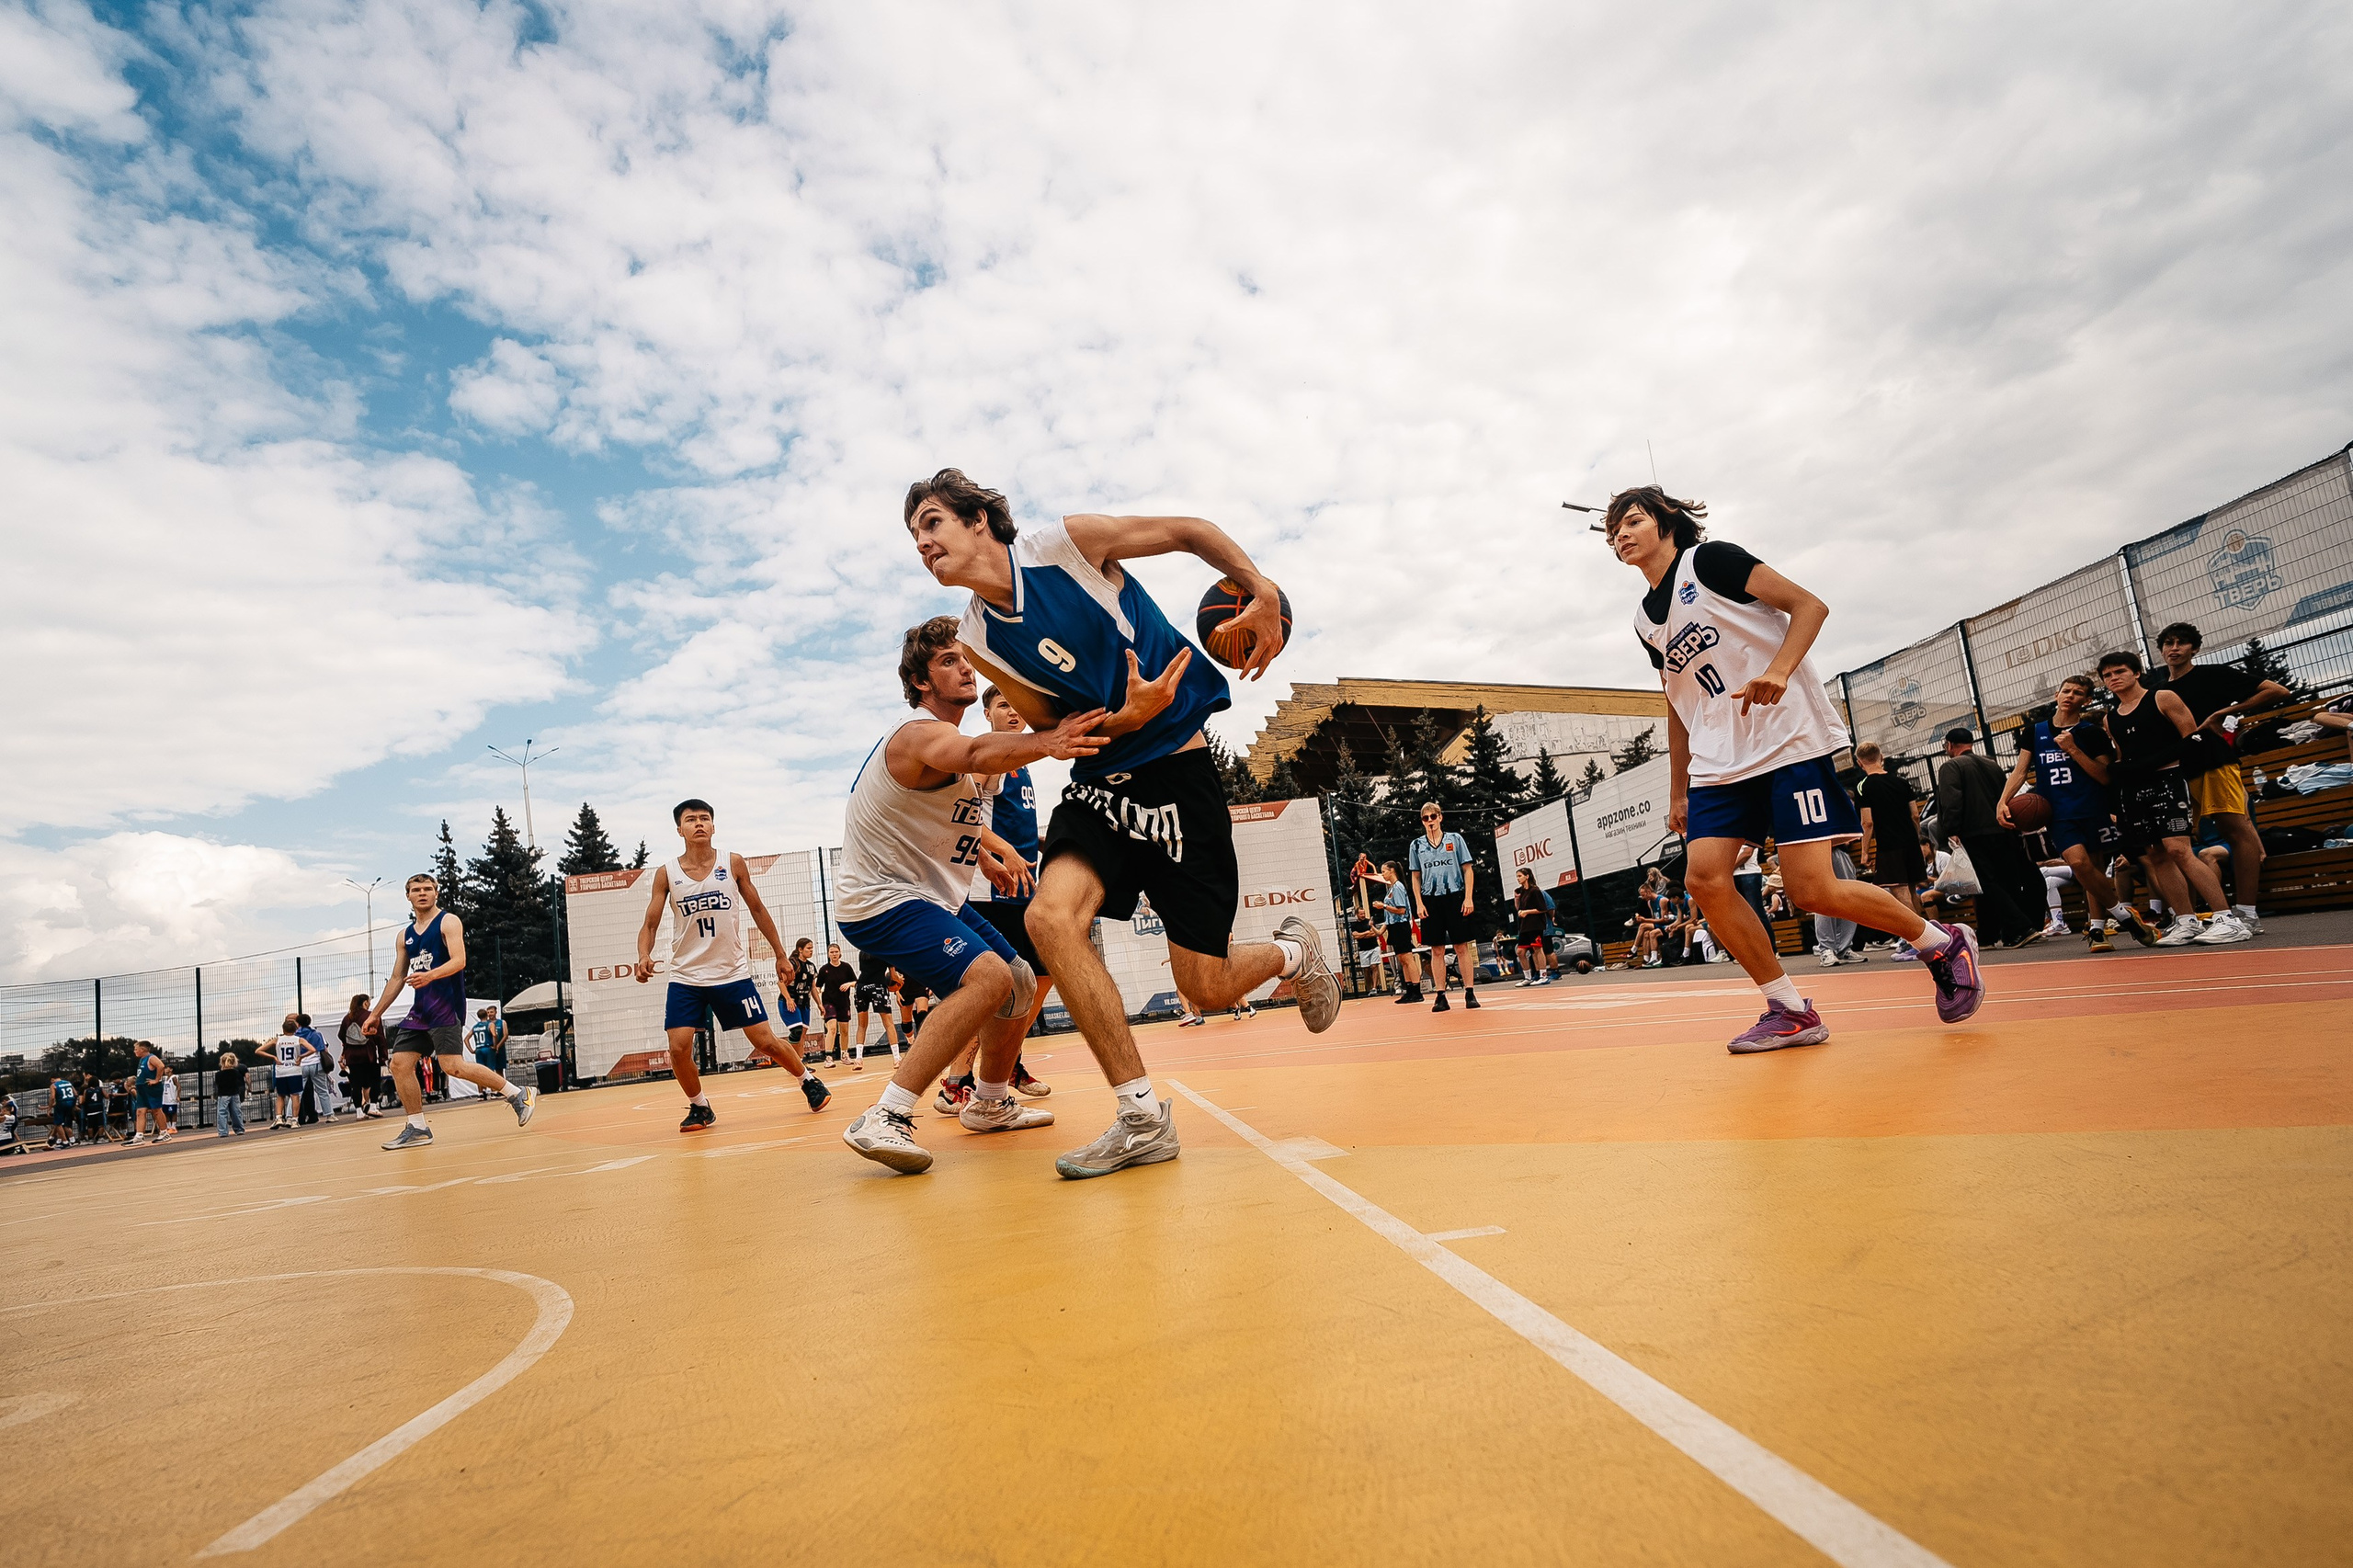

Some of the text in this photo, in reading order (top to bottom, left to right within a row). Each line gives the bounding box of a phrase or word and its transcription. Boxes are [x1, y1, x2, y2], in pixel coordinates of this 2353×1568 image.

[2215, 574, 2283, 608] ТВЕРЬ
[1038, 638, 1075, 672] 9
[1695, 664, 1726, 699] 10
[1891, 707, 1927, 727] ТВЕРЬ
[2050, 767, 2072, 785] 23
[1021, 786, 1036, 809] 99
[1793, 789, 1827, 825] 10
[1597, 800, 1651, 830] appzone.co
[950, 835, 981, 866] 99
[1526, 838, 1553, 863] DKC
[1433, 858, 1453, 867] DKC
[677, 895, 731, 916] ТВЕРЬ
[1268, 888, 1316, 906] DKC
[697, 917, 715, 937] 14
[742, 995, 762, 1018] 14
[475, 1031, 485, 1043] 10
[280, 1047, 294, 1061] 19
[62, 1086, 74, 1099] 13
[91, 1092, 97, 1101] 4
